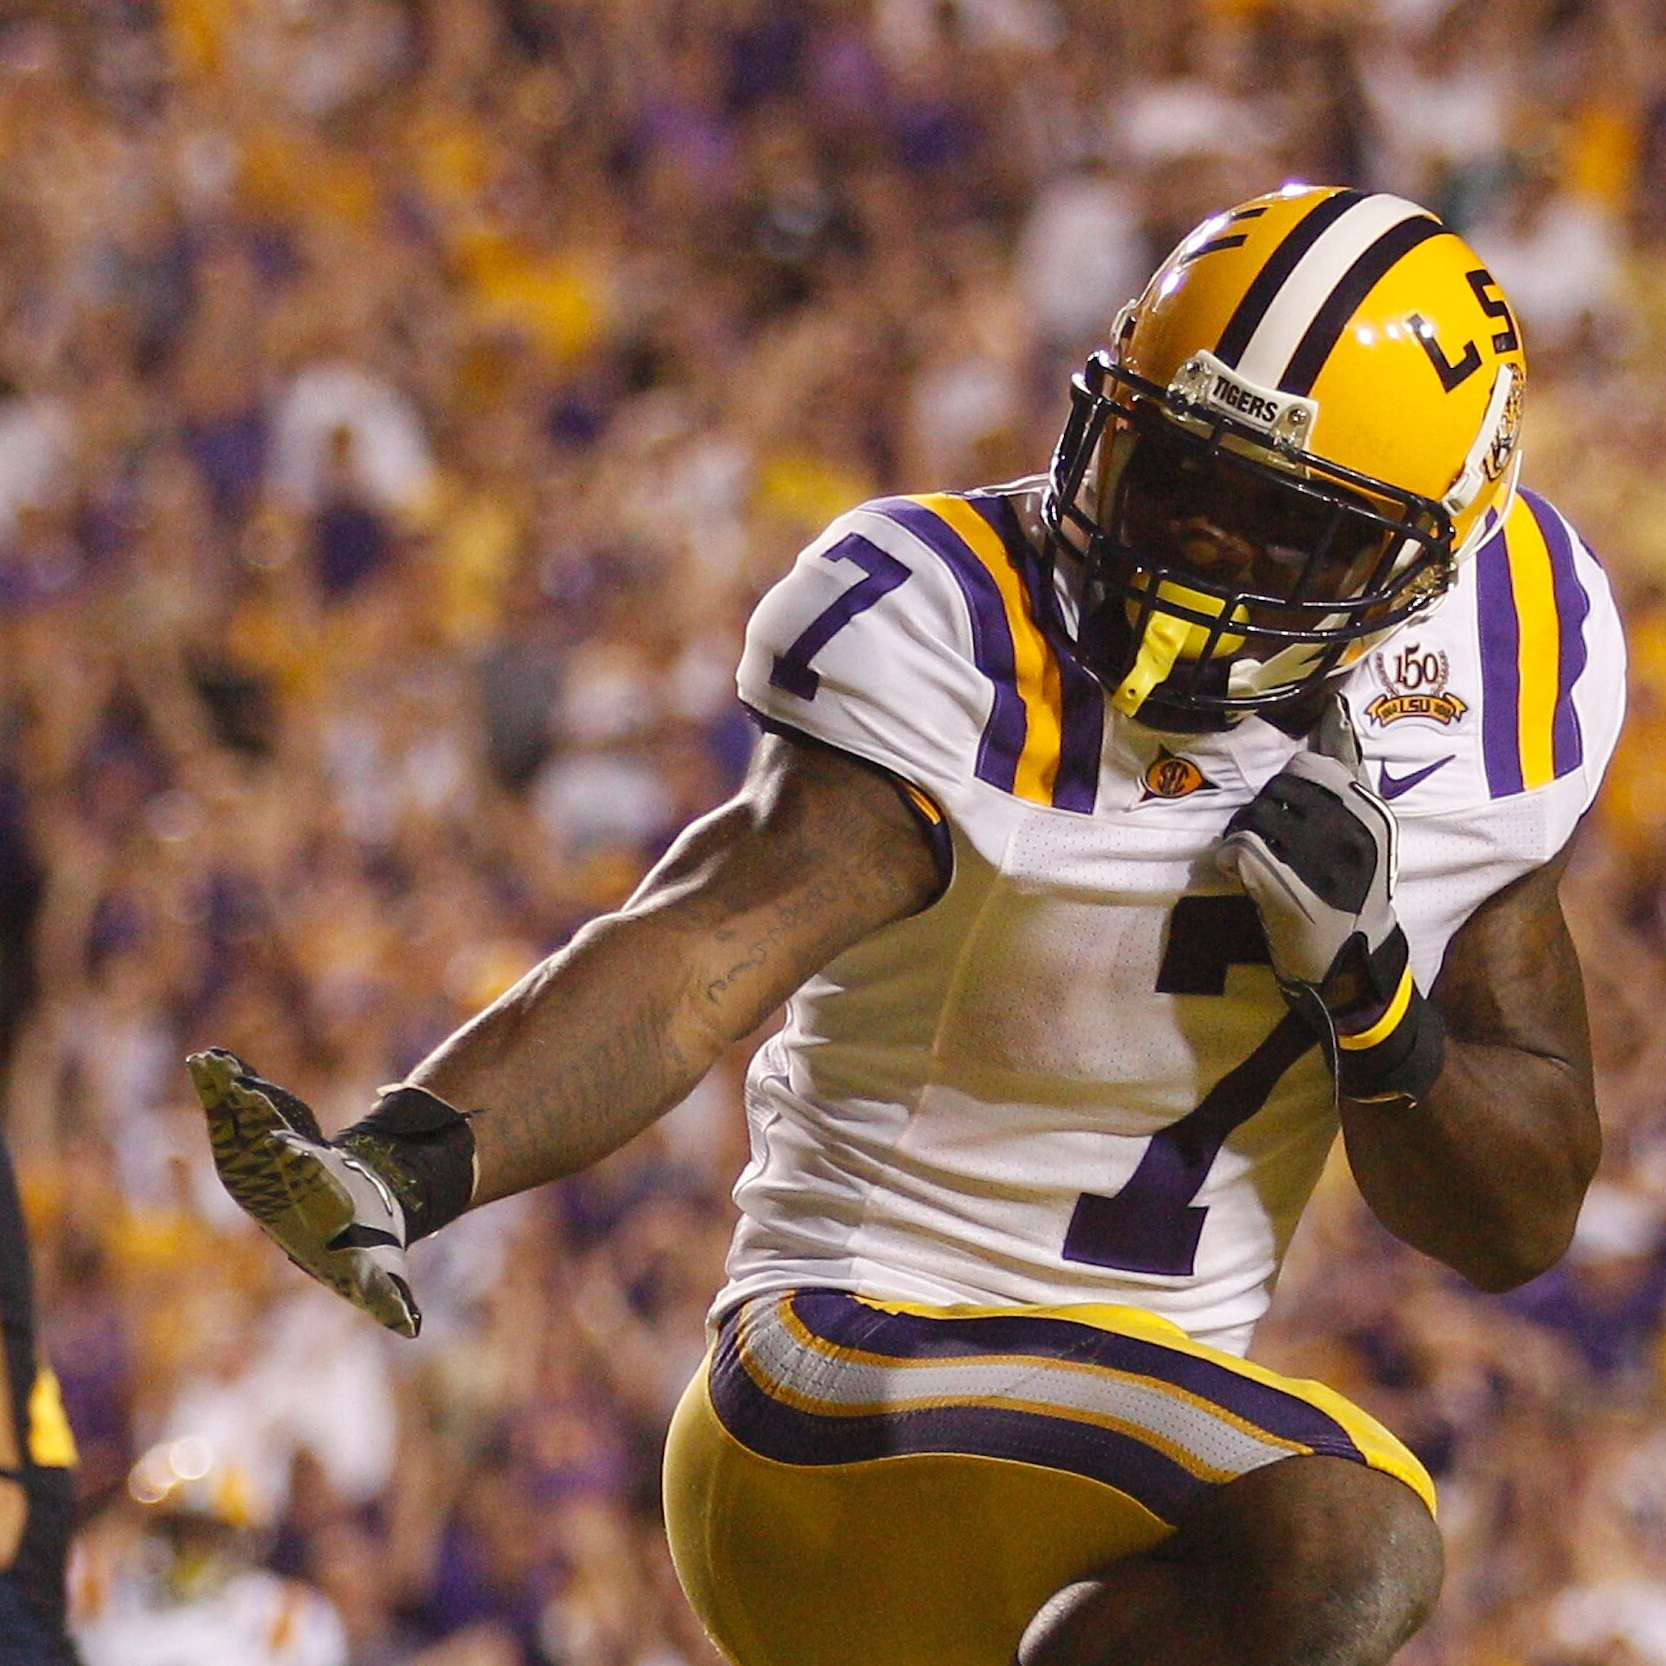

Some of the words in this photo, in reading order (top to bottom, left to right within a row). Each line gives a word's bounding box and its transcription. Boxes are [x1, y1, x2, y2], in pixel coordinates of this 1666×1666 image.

[1405, 269, 1519, 393] LS
[1213, 375, 1278, 422] TIGERS
[768, 532, 913, 702] 7
[1393, 643, 1439, 690] 150
[1399, 699, 1431, 713] LSU
[1061, 894, 1325, 1277] 7
